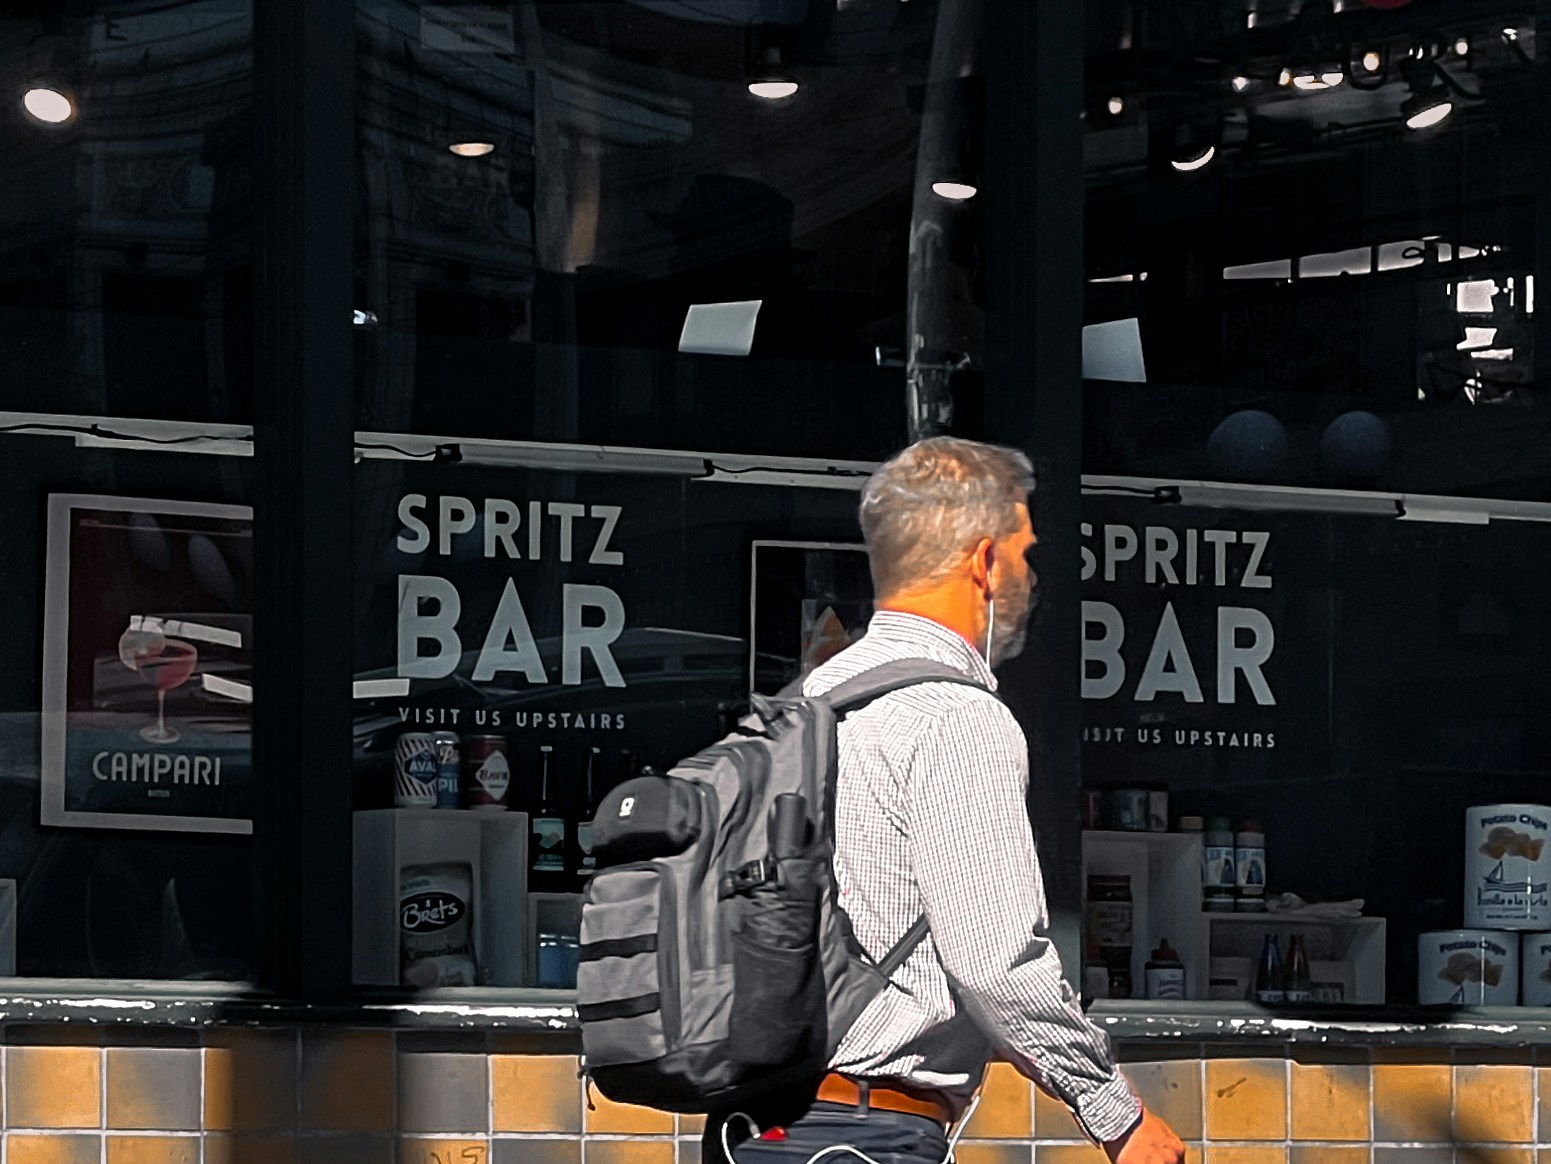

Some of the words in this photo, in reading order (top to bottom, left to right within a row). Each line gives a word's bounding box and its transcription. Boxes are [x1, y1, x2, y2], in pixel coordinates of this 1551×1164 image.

[396, 493, 625, 566] SPRITZ
[396, 573, 627, 688] BAR
[1080, 599, 1277, 706] BAR
[398, 706, 461, 725] VISIT
[474, 709, 501, 726] US
[515, 711, 626, 730] UPSTAIRS
[1082, 727, 1125, 743] ISIT
[1137, 728, 1162, 744] US
[1175, 730, 1276, 748] UPSTAIRS
[92, 751, 221, 786] CAMPARI
